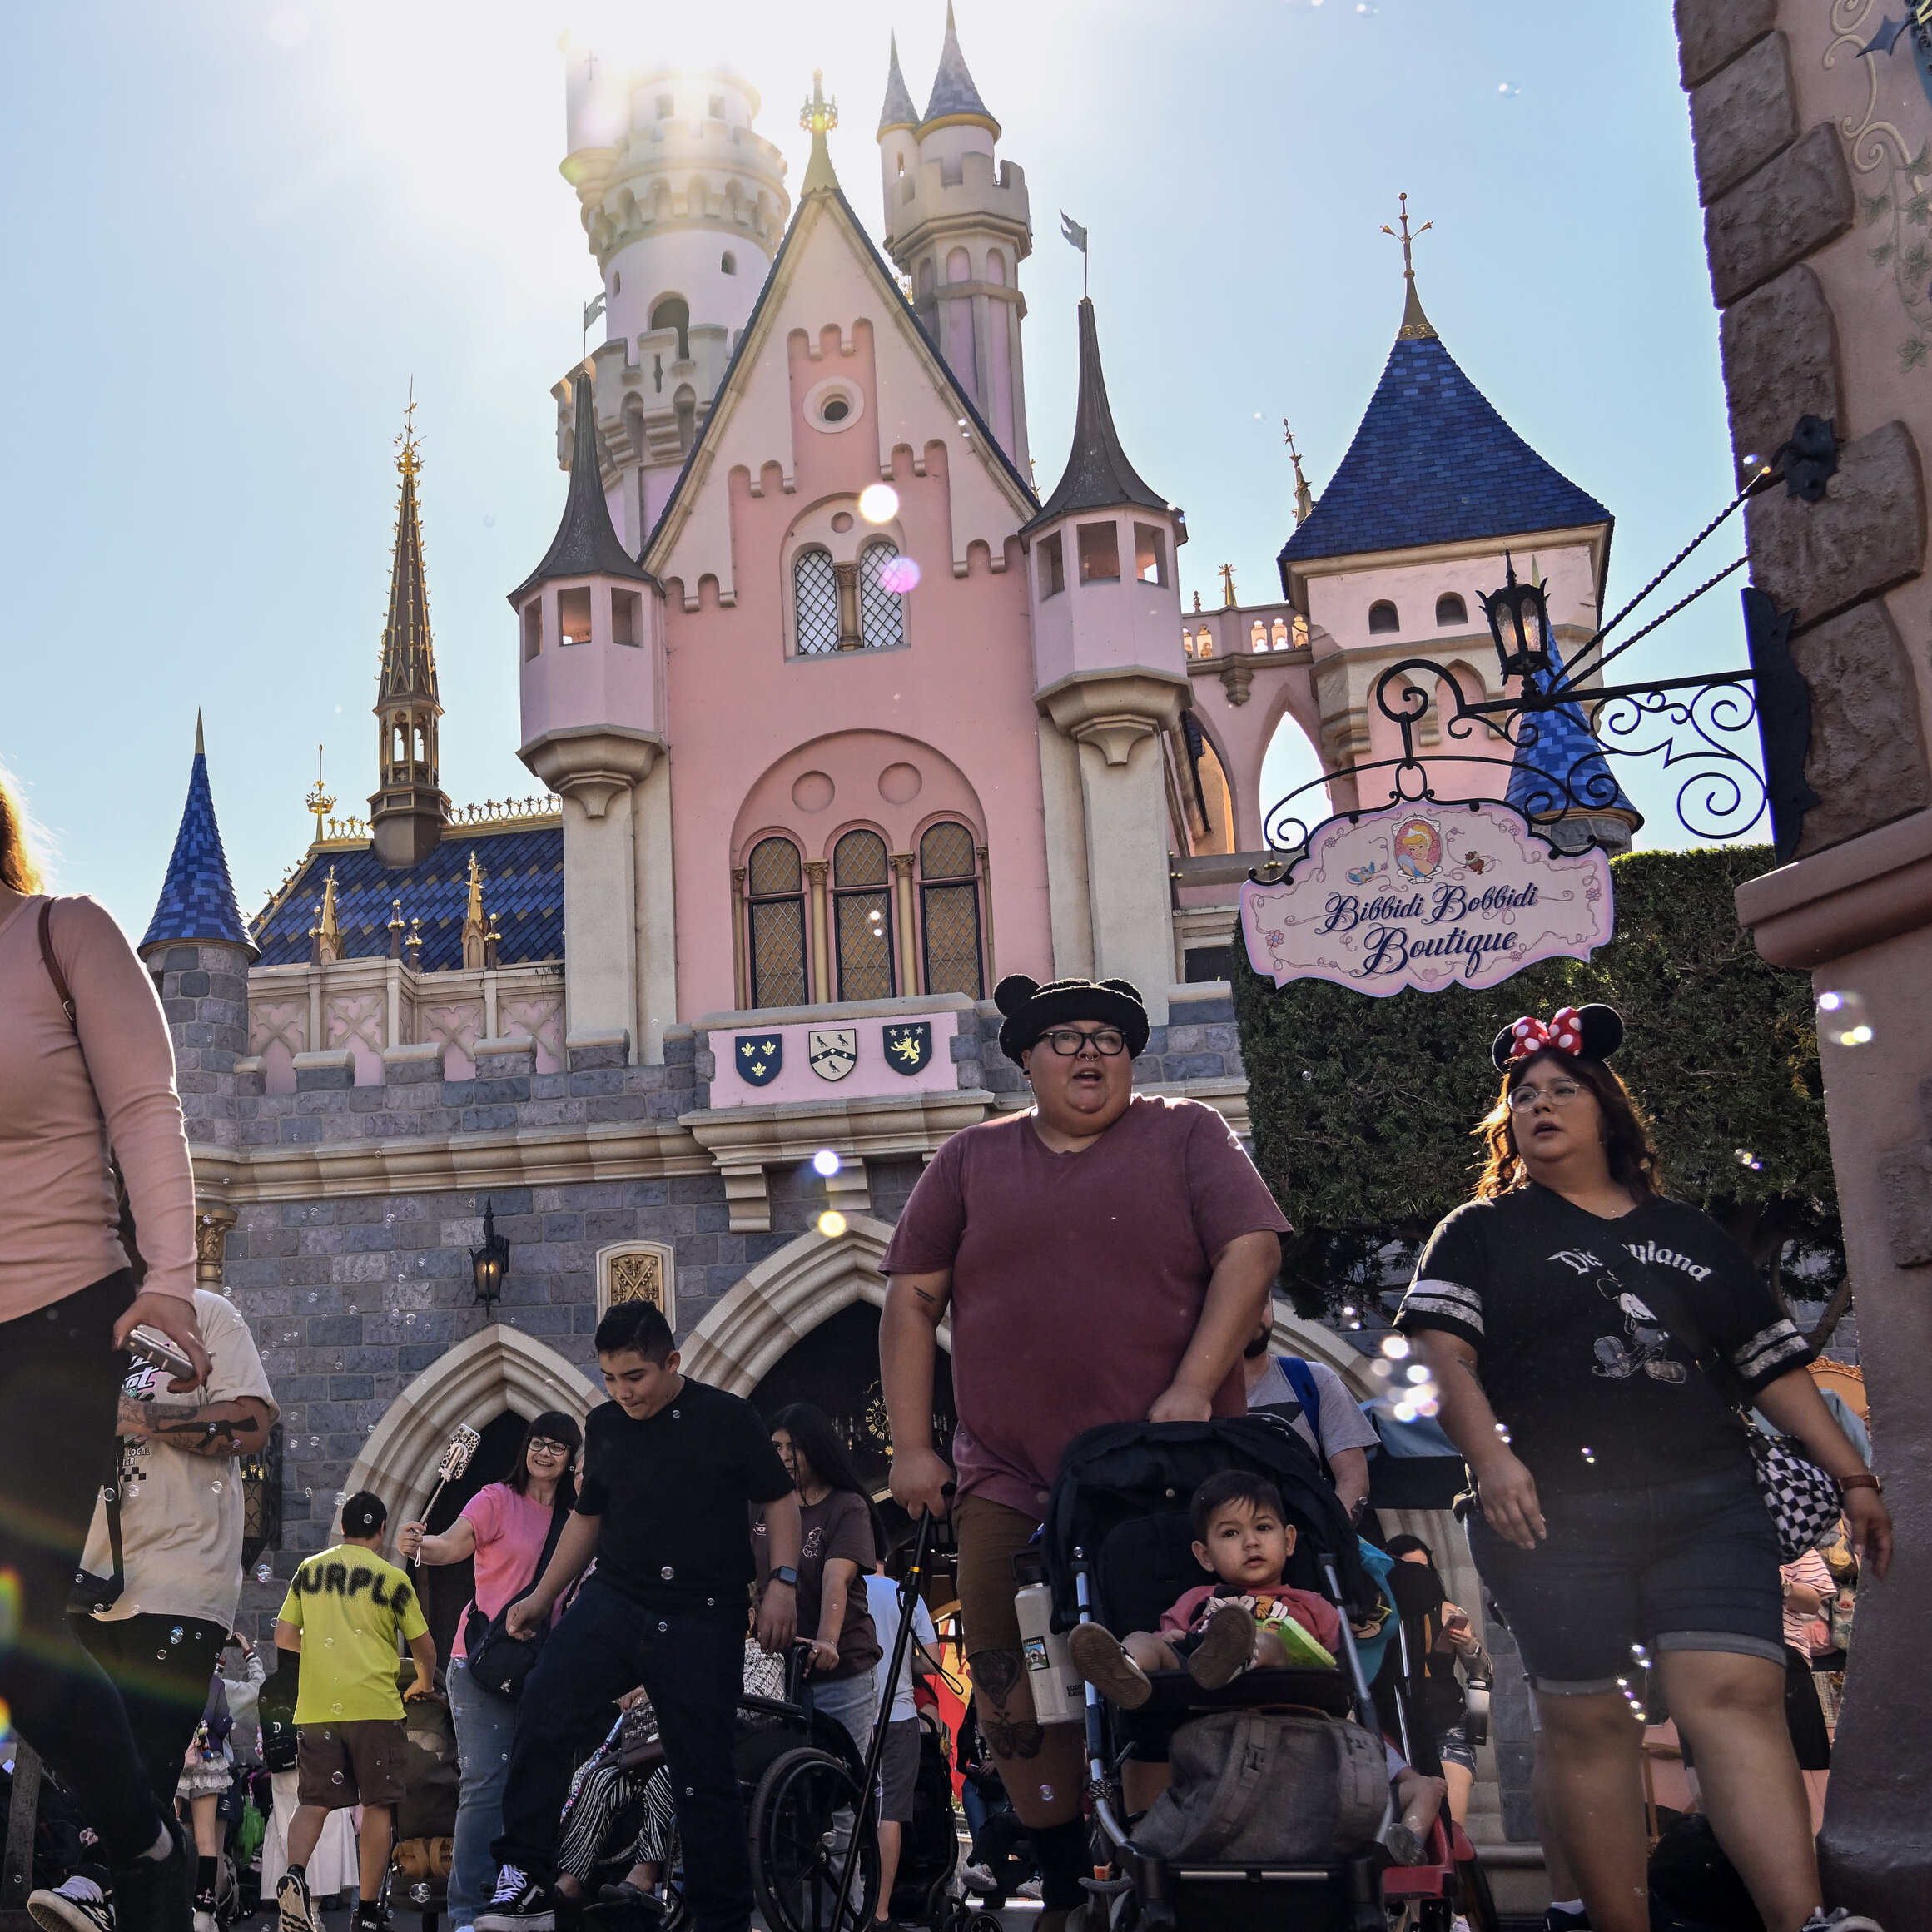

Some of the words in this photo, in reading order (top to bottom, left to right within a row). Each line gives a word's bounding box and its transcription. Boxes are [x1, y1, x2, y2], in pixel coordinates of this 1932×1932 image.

[1314, 892, 1424, 934] Bibbidi
[1421, 882, 1537, 925] Bobbidi
[1350, 923, 1517, 978] Boutique
[127, 1448, 150, 1457] LOCAL
[273, 1721, 281, 1733] D
